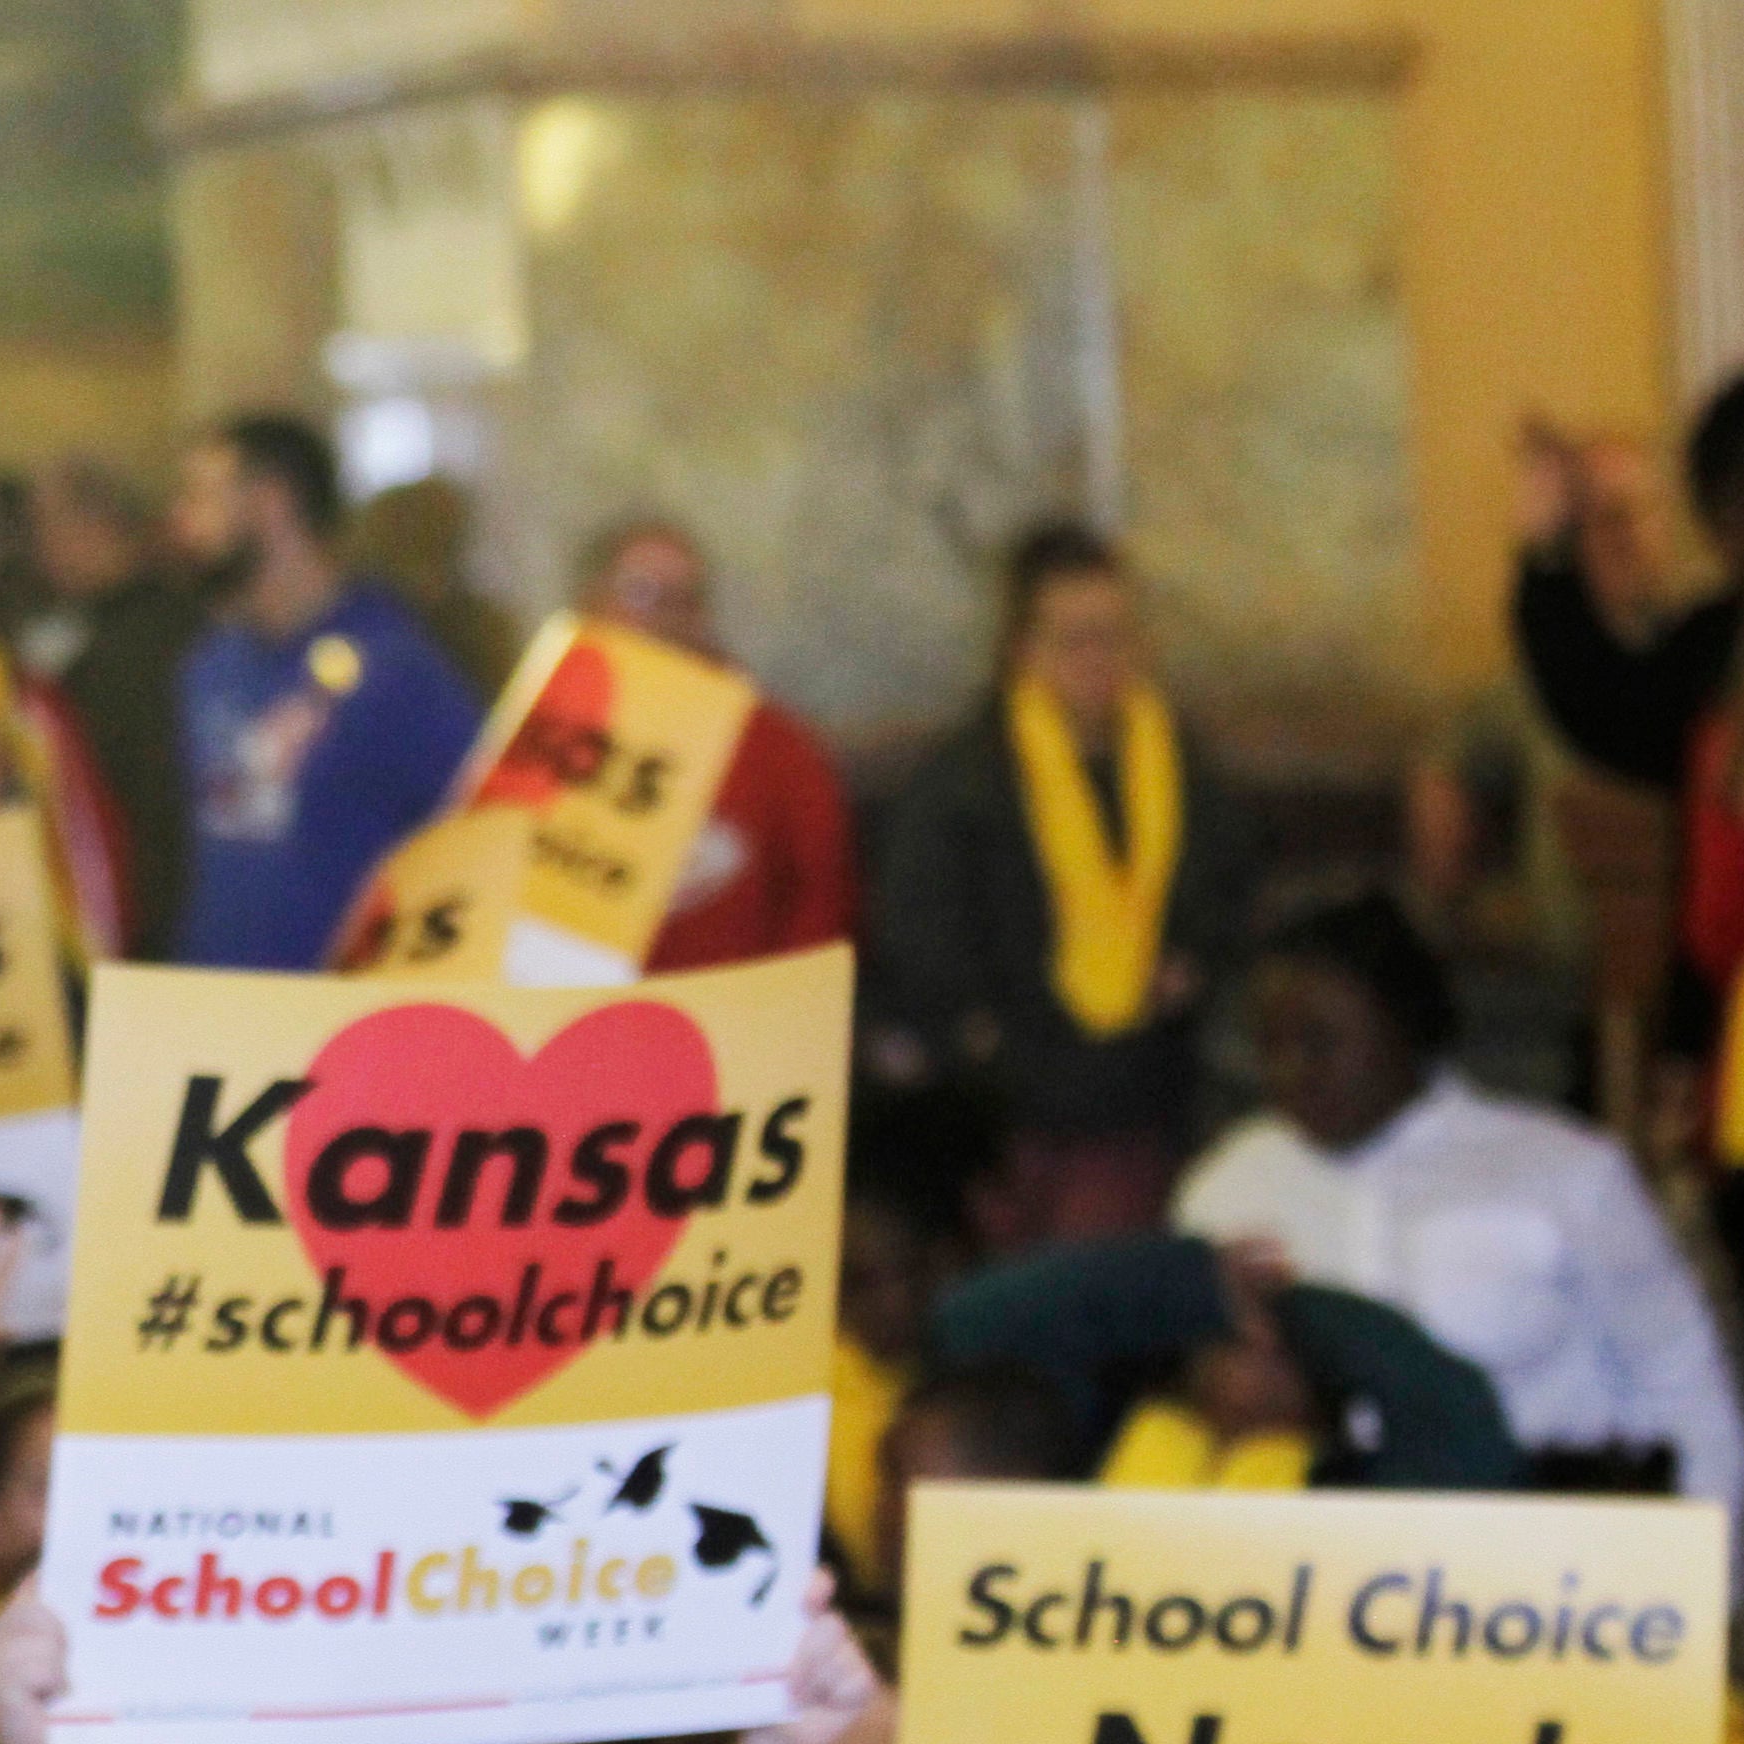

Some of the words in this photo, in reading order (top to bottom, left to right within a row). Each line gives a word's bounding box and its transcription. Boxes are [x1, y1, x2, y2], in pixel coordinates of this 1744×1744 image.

[156, 1073, 813, 1229] Kansas
[137, 1248, 804, 1354] #schoolchoice
[110, 1510, 334, 1538] NATIONAL
[958, 1559, 1310, 1656] School
[1347, 1569, 1685, 1663] Choice
